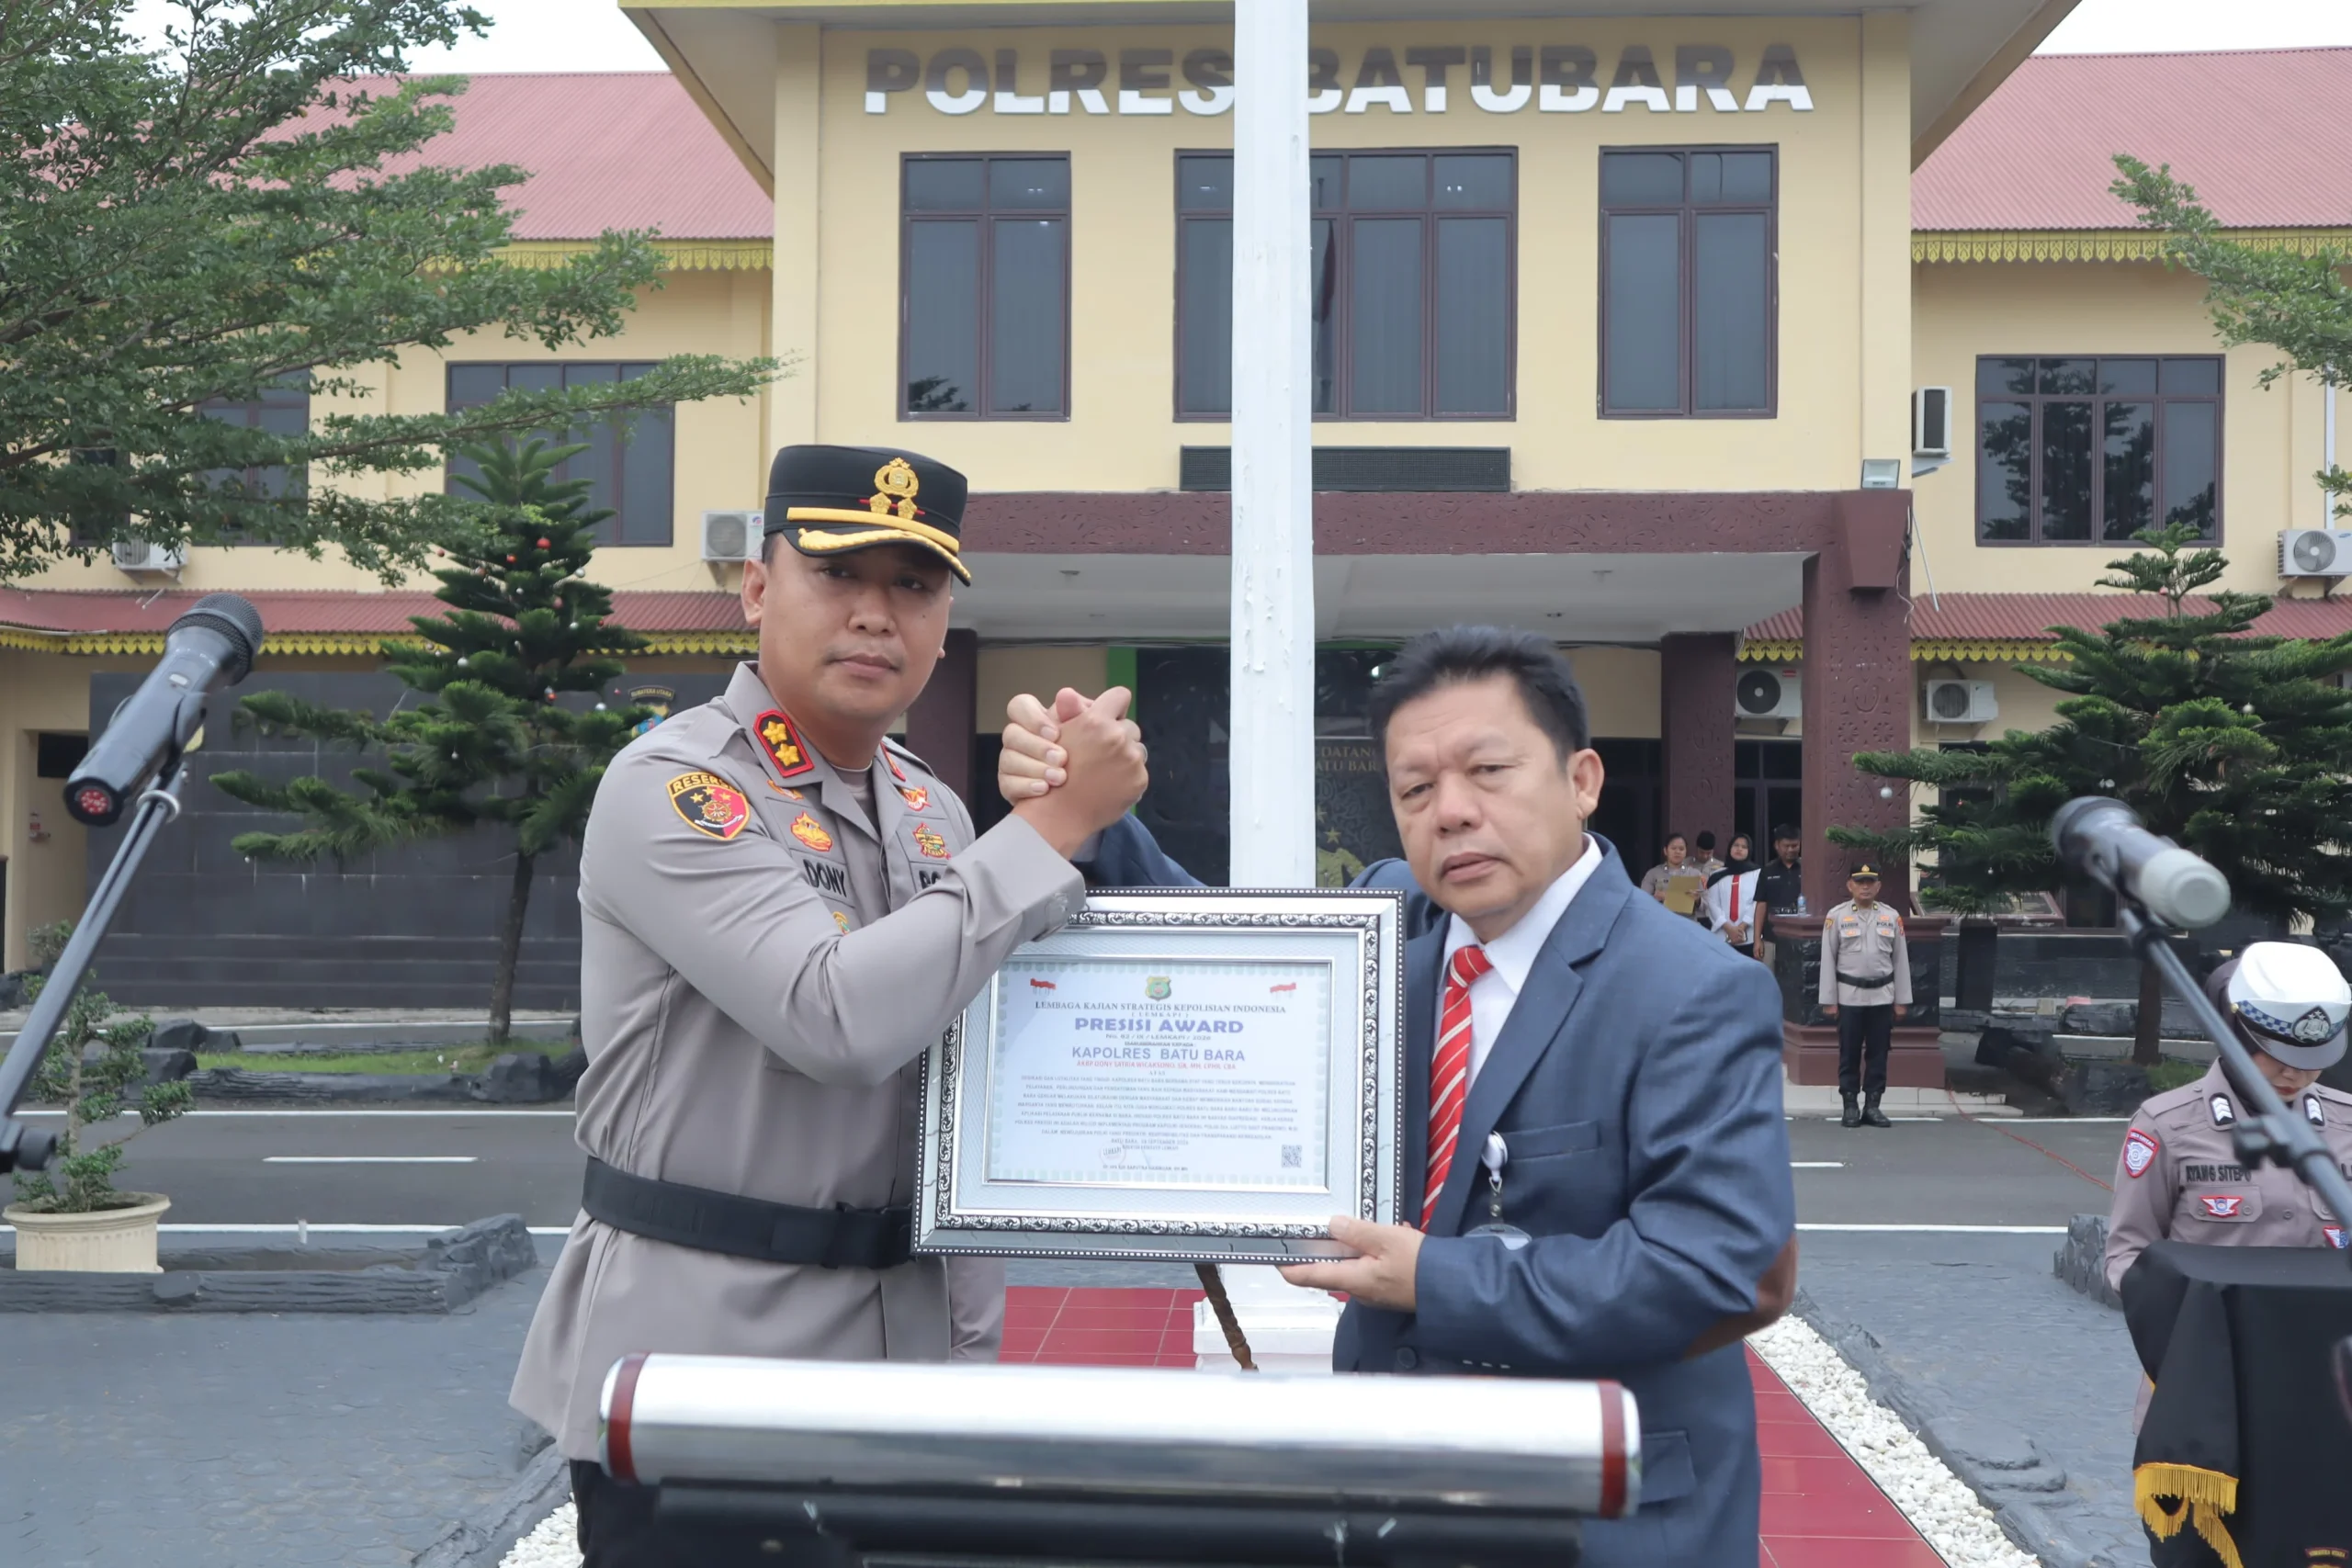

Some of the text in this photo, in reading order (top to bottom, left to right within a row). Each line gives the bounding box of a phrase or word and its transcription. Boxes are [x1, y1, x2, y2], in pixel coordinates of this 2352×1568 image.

[865, 47, 1235, 115] POLRES
[1321, 745, 1375, 758] DATAN
[1315, 760, 1378, 772] ATU BAR
[803, 858, 847, 897] DONY
[1035, 1000, 1286, 1013] LEMBAGA KAJIAN STRATEGIS KEPOLISIAN INDONESIA
[1075, 1017, 1244, 1033] PRESISI AWARD
[1072, 1046, 1245, 1062] KAPOLRES BATU BARA
[1094, 1060, 1112, 1068] DONY
